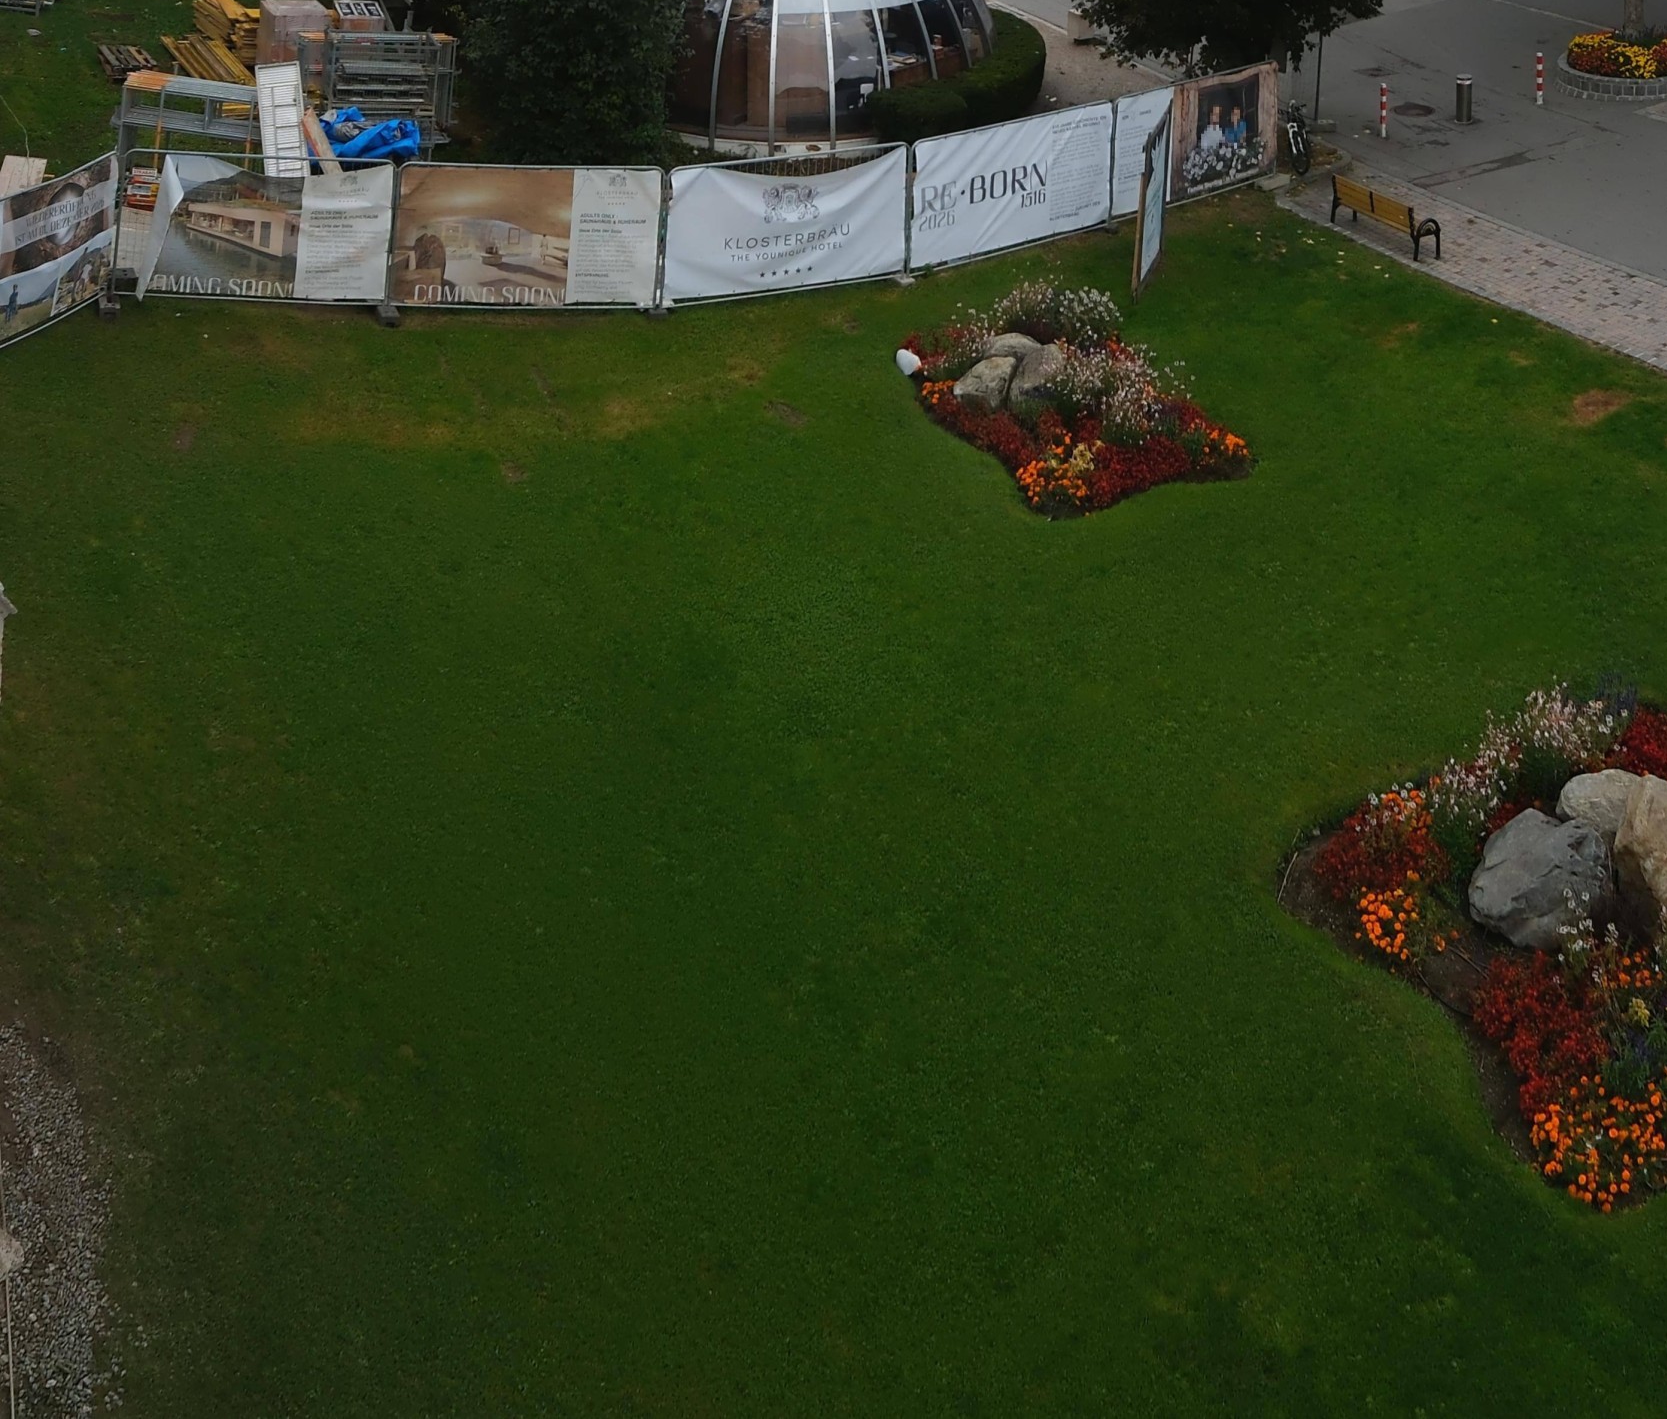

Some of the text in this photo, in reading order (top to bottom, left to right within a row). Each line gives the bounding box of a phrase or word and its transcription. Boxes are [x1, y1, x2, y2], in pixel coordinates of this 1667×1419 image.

[1021, 188, 1046, 209] 1516
[918, 210, 956, 232] 2026
[724, 222, 851, 250] KLOSTERBRÄU
[731, 241, 843, 262] THE YOUNIQUE HOTEL
[153, 274, 221, 294] OMING
